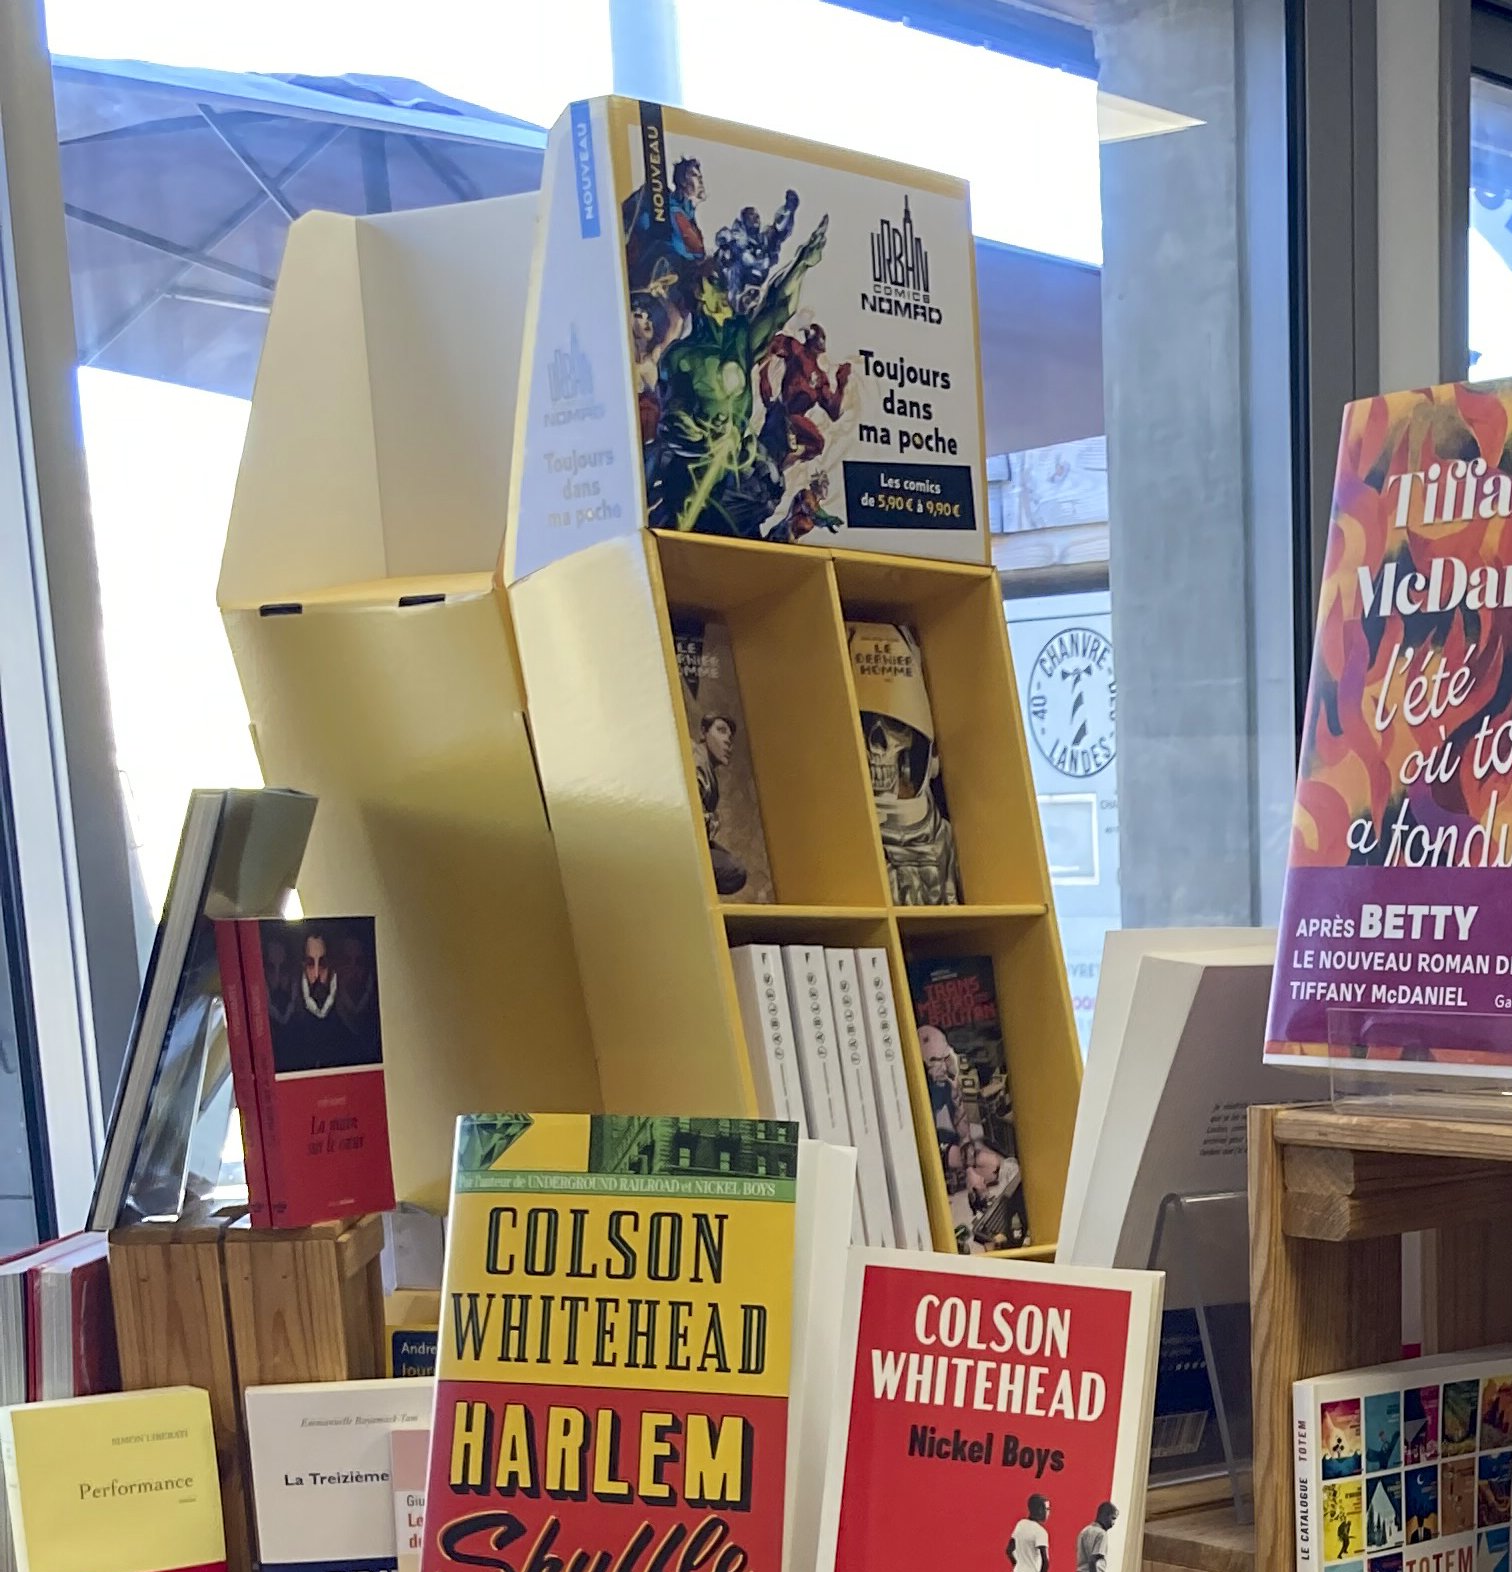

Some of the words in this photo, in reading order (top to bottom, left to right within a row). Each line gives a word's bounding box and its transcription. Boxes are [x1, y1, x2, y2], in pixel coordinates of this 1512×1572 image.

[646, 126, 666, 223] NOUVEAU
[859, 350, 951, 390] Toujours
[882, 391, 933, 420] dans
[859, 423, 891, 446] ma
[899, 425, 958, 456] poche
[880, 473, 902, 492] Les
[904, 477, 941, 495] comics
[1039, 632, 1108, 678] CHANVRE
[1049, 737, 1111, 773] LANDES
[1296, 914, 1355, 940] APRÈS
[1359, 902, 1479, 941] BETTY
[1292, 949, 1314, 970] LE
[1318, 951, 1412, 974] NOUVEAU
[1418, 954, 1489, 974] ROMAN
[1290, 981, 1365, 1002] TIFFANY
[1370, 984, 1468, 1008] McDANIEL
[528, 1177, 617, 1192] UNDERGROUND
[619, 1177, 679, 1193] RAILROAD
[682, 1181, 692, 1194] et
[694, 1180, 740, 1195] NICKEL
[743, 1181, 775, 1196] BOYS
[485, 1207, 728, 1284] COLSON
[451, 1293, 767, 1375] WHITEHEAD
[915, 1295, 1072, 1358] COLSON
[871, 1349, 1106, 1423] WHITEHEAD
[449, 1400, 751, 1512] HARLEM
[908, 1424, 993, 1465] Nickel
[1002, 1440, 1065, 1478] Boys
[1298, 1420, 1307, 1461] TOTEM
[79, 1474, 194, 1500] Performance
[285, 1473, 303, 1486] La
[309, 1469, 390, 1486] Treizième
[1299, 1477, 1308, 1540] CATALOGUE
[1300, 1545, 1309, 1560] LE
